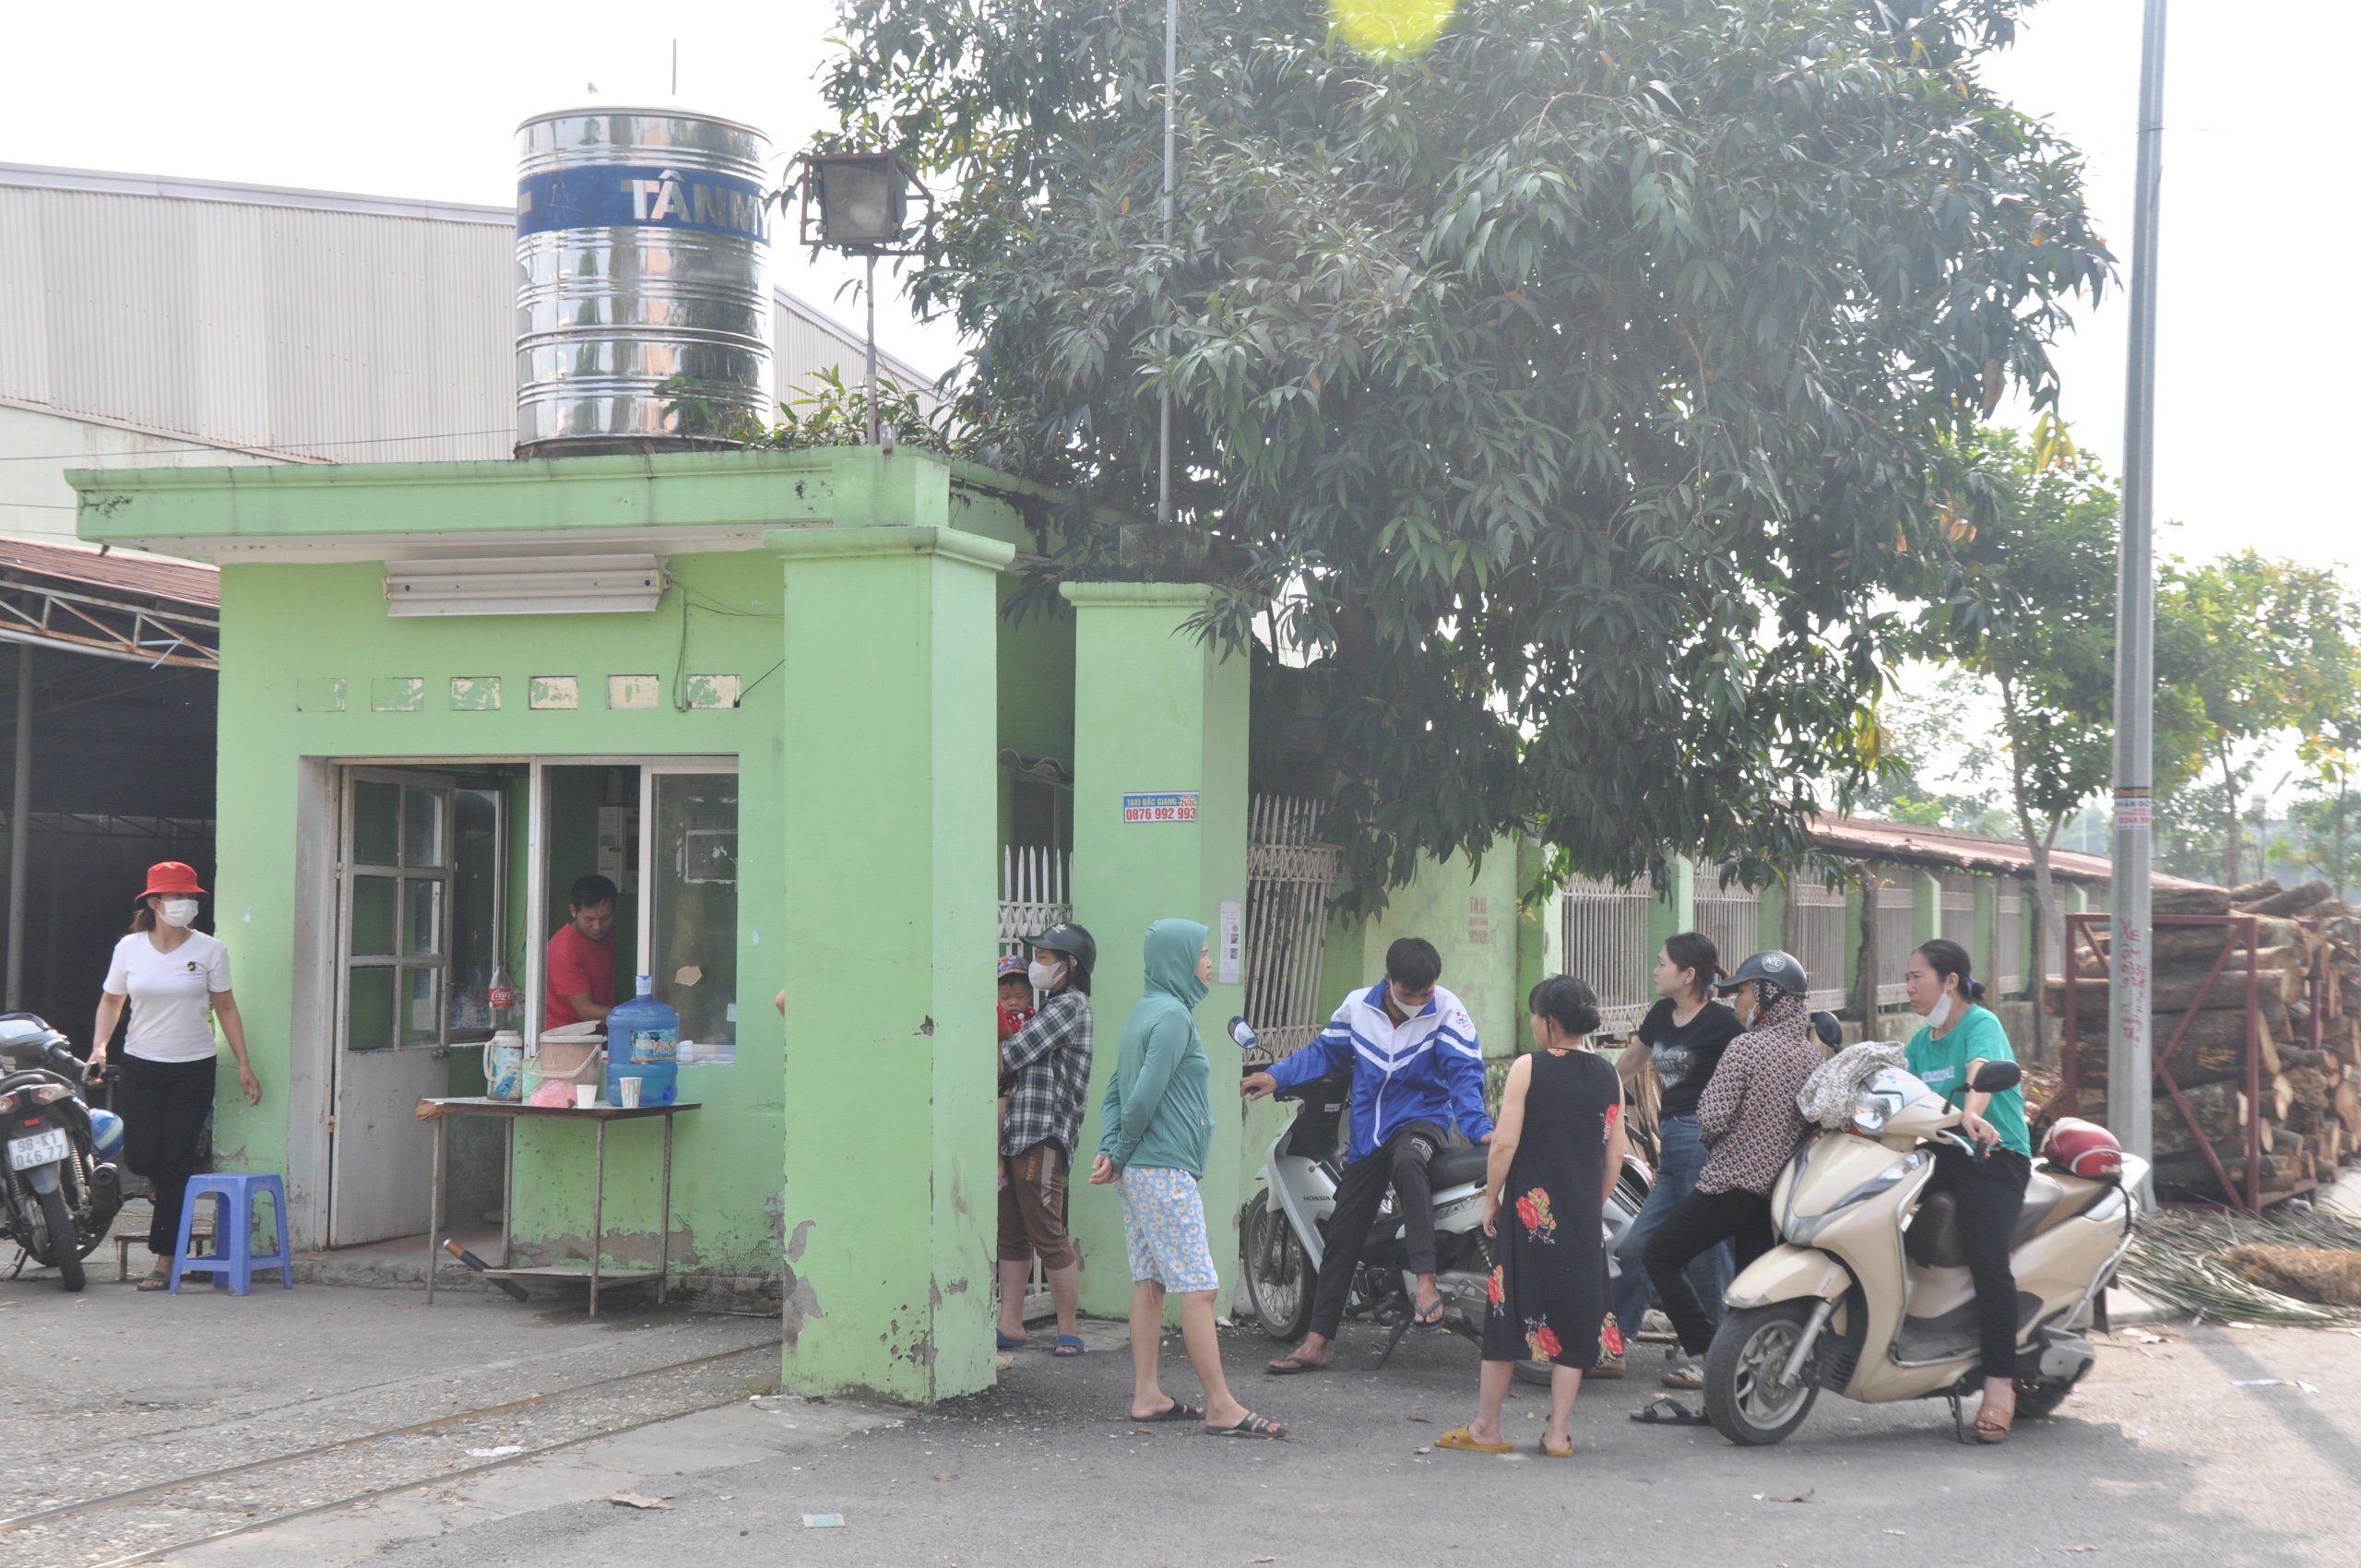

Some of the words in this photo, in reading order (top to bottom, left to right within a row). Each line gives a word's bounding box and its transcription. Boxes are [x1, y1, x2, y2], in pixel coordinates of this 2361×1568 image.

[1157, 797, 1177, 805] GIANG
[1126, 808, 1151, 820] 0876
[1155, 807, 1174, 819] 992
[1178, 807, 1195, 819] 993
[18, 1133, 57, 1153] 98-K1
[16, 1145, 64, 1168] 046.77
